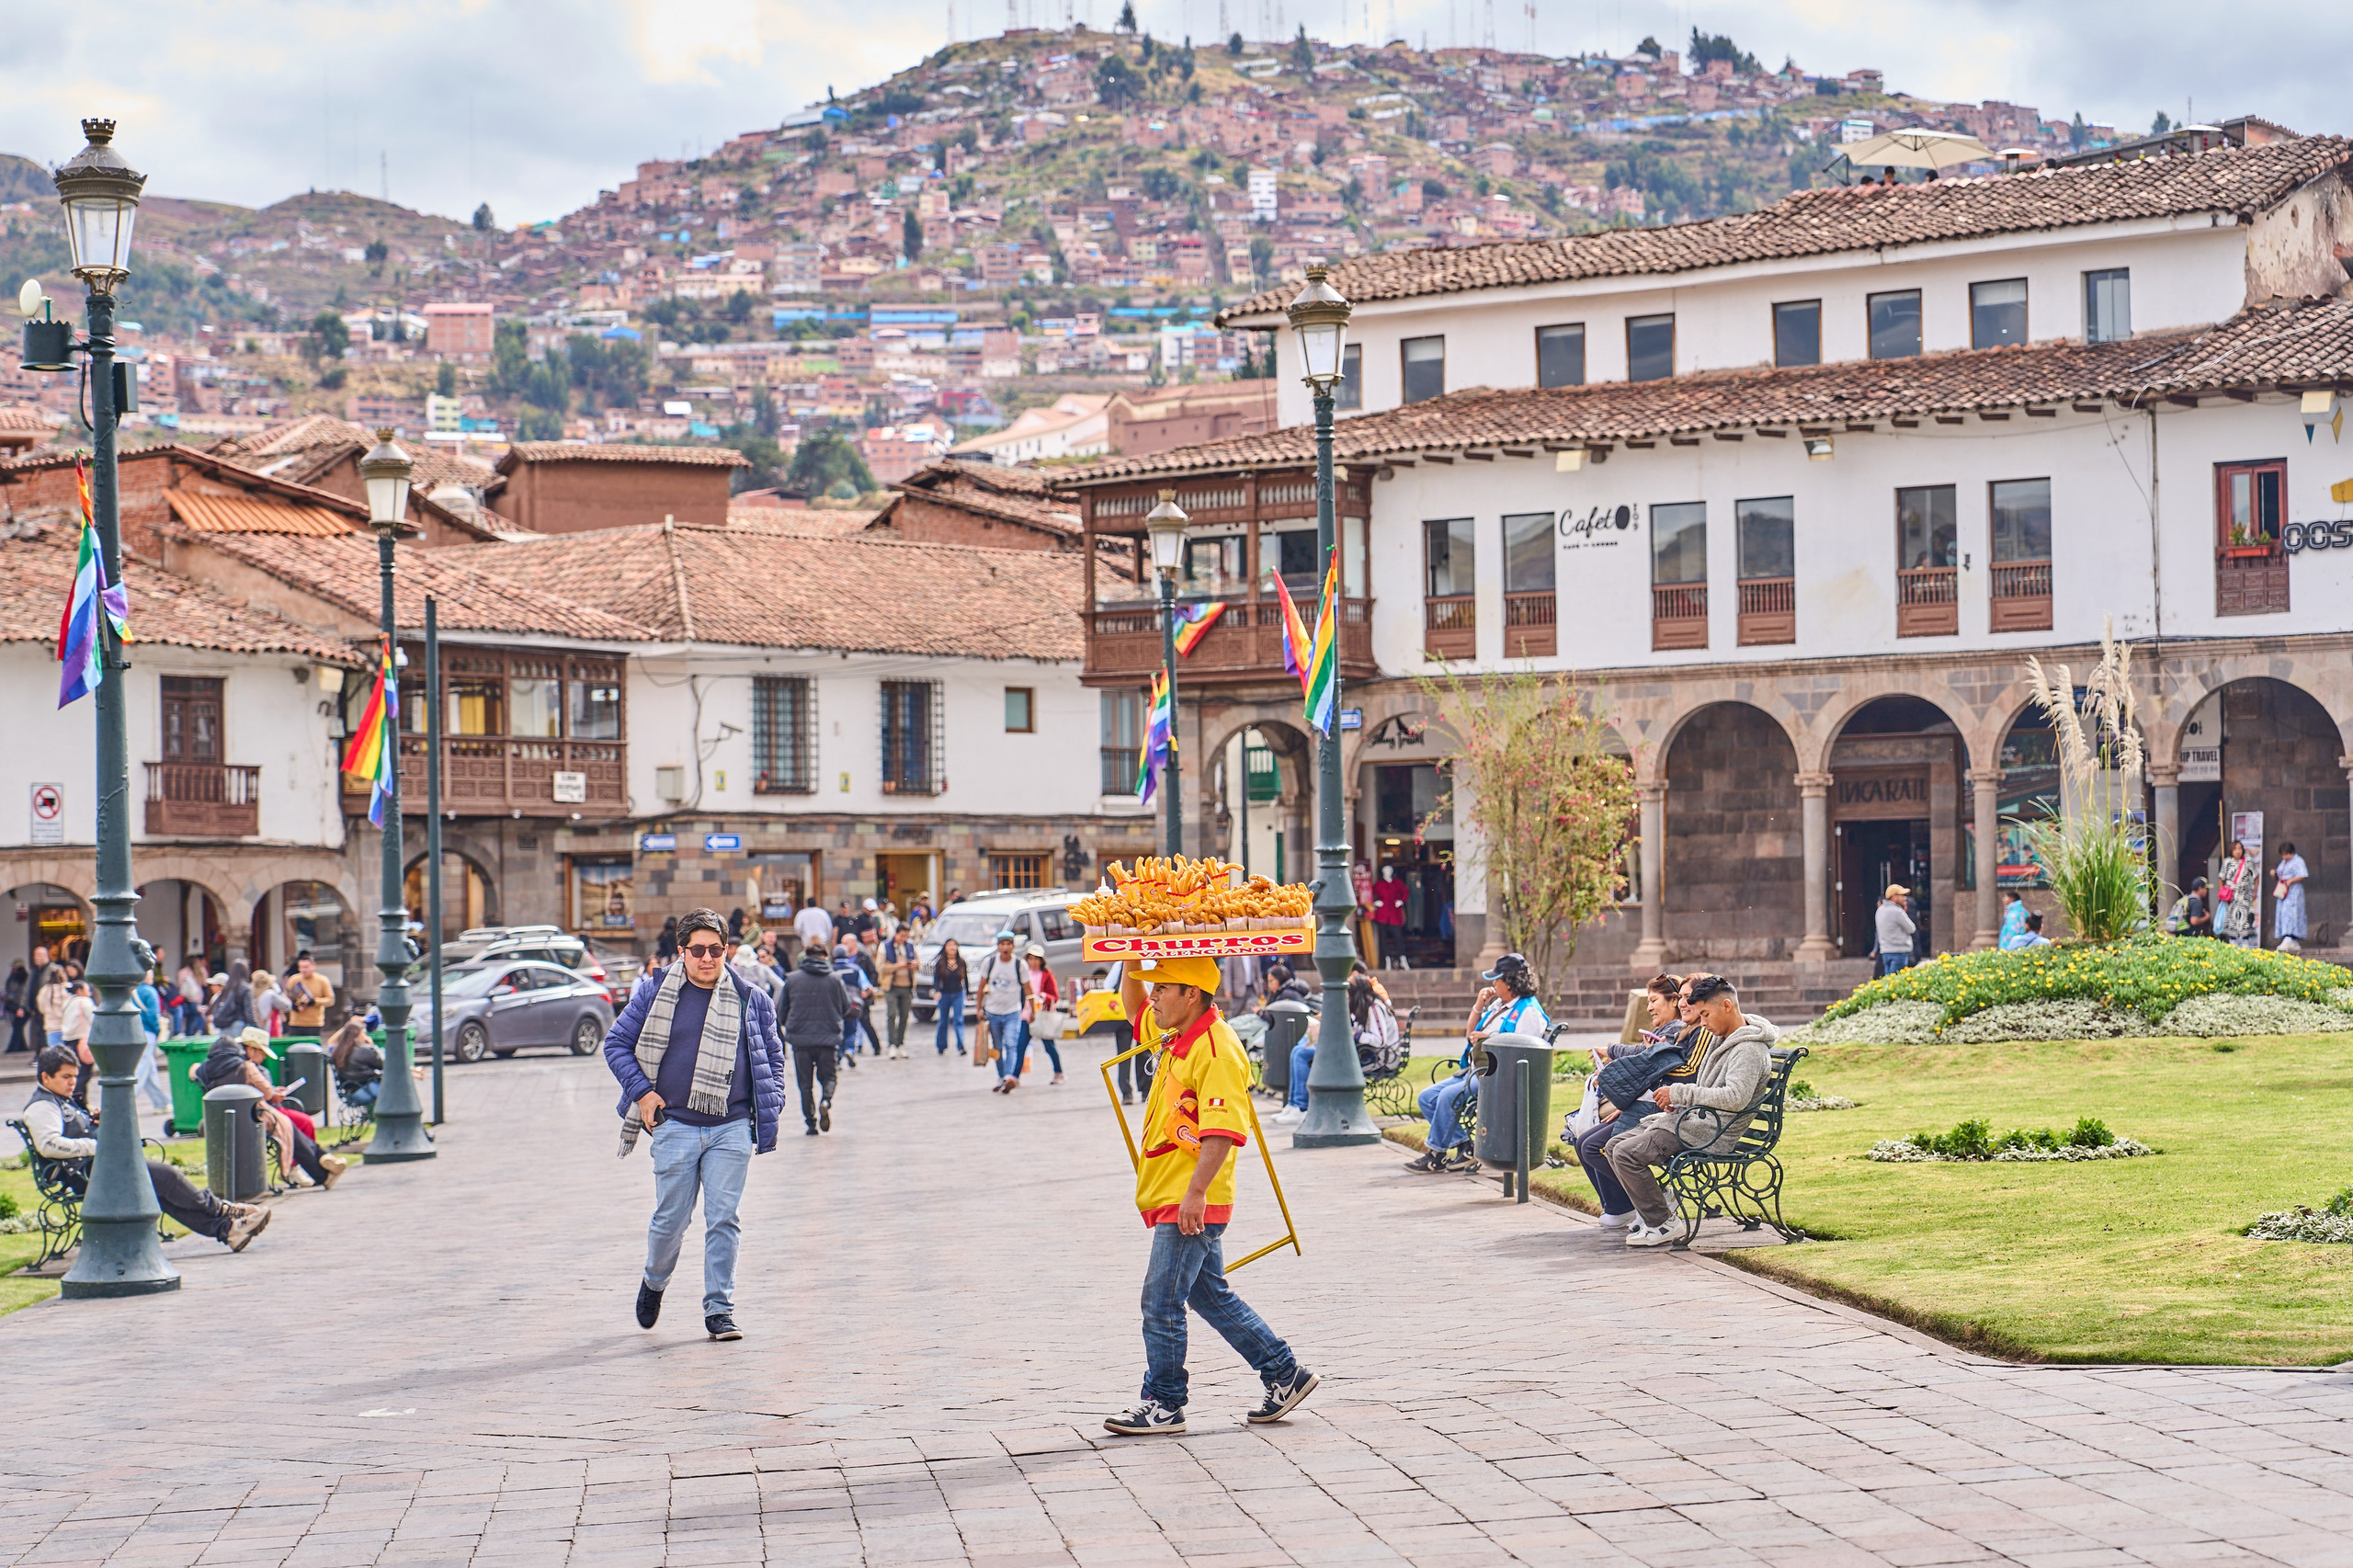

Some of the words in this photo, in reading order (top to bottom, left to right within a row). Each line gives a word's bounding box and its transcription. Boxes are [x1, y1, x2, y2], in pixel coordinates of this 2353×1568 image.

[2192, 750, 2218, 762] TRAVEL
[1092, 934, 1304, 953] Churros
[1137, 946, 1279, 958] VALENCIANOS
